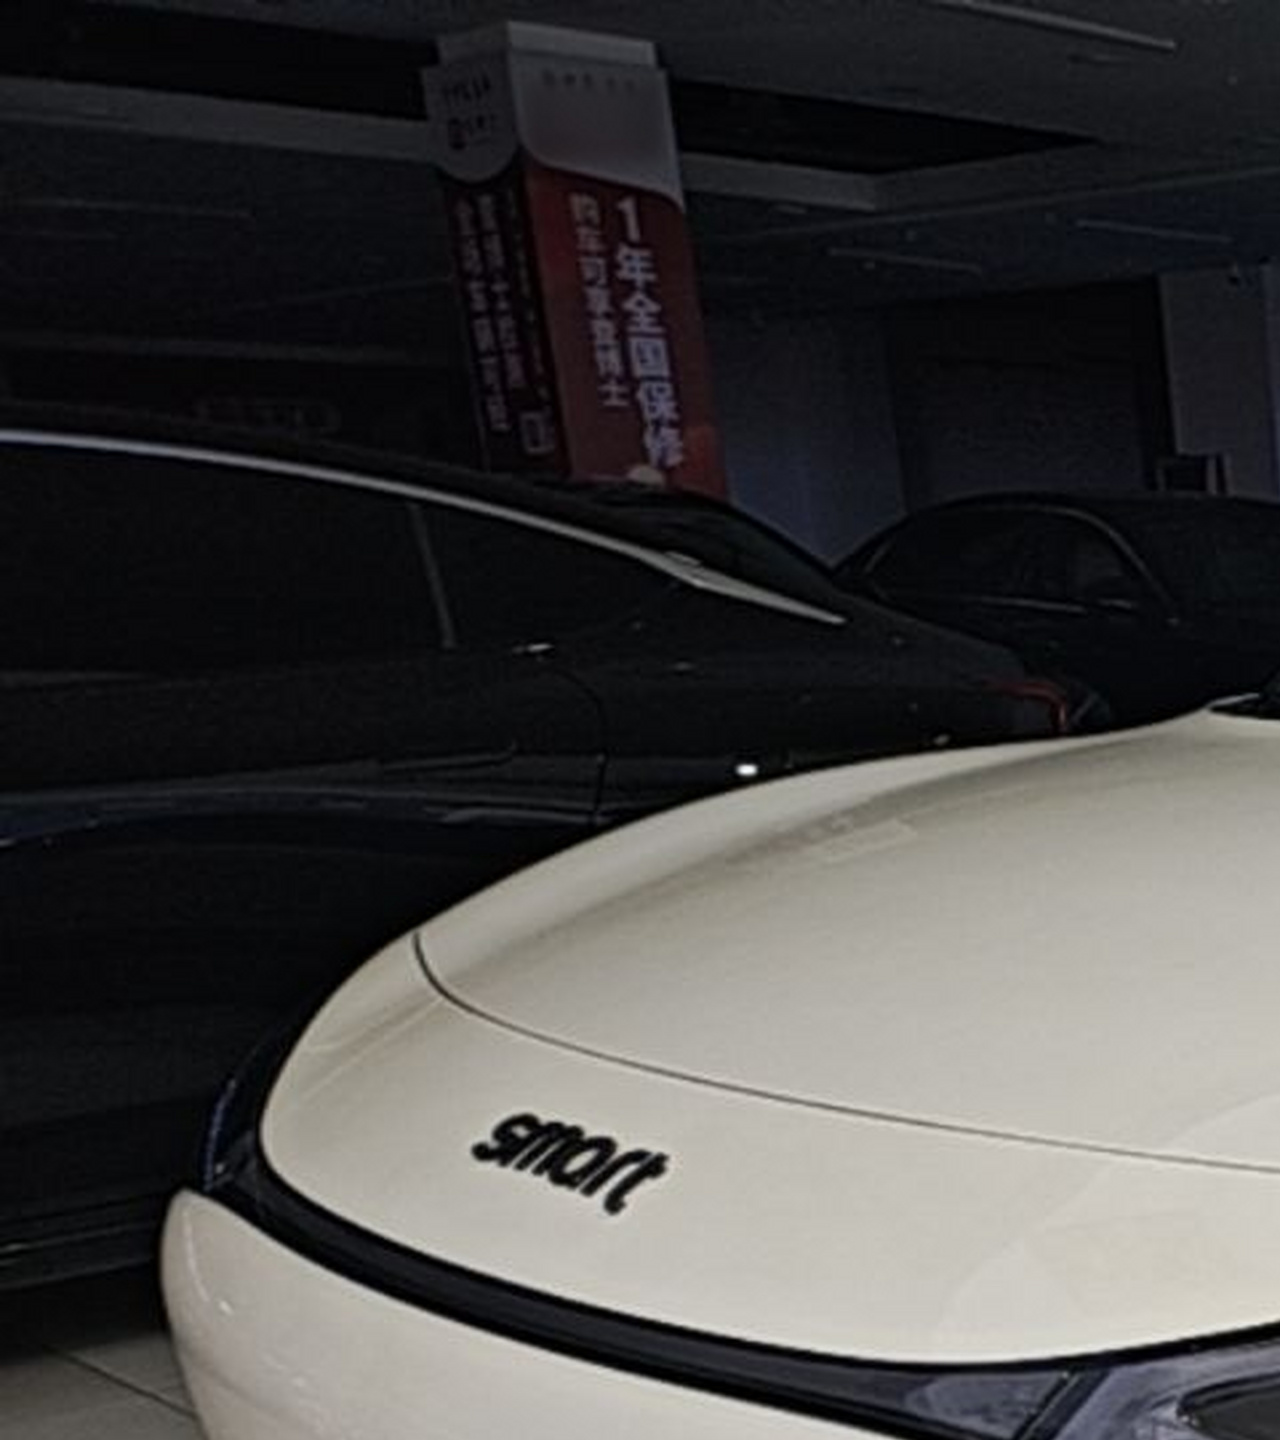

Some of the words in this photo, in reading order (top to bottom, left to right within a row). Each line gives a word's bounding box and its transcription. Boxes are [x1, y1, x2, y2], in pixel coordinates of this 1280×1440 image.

[615, 196, 684, 468] 1年全国保修
[471, 1113, 669, 1216] smart
